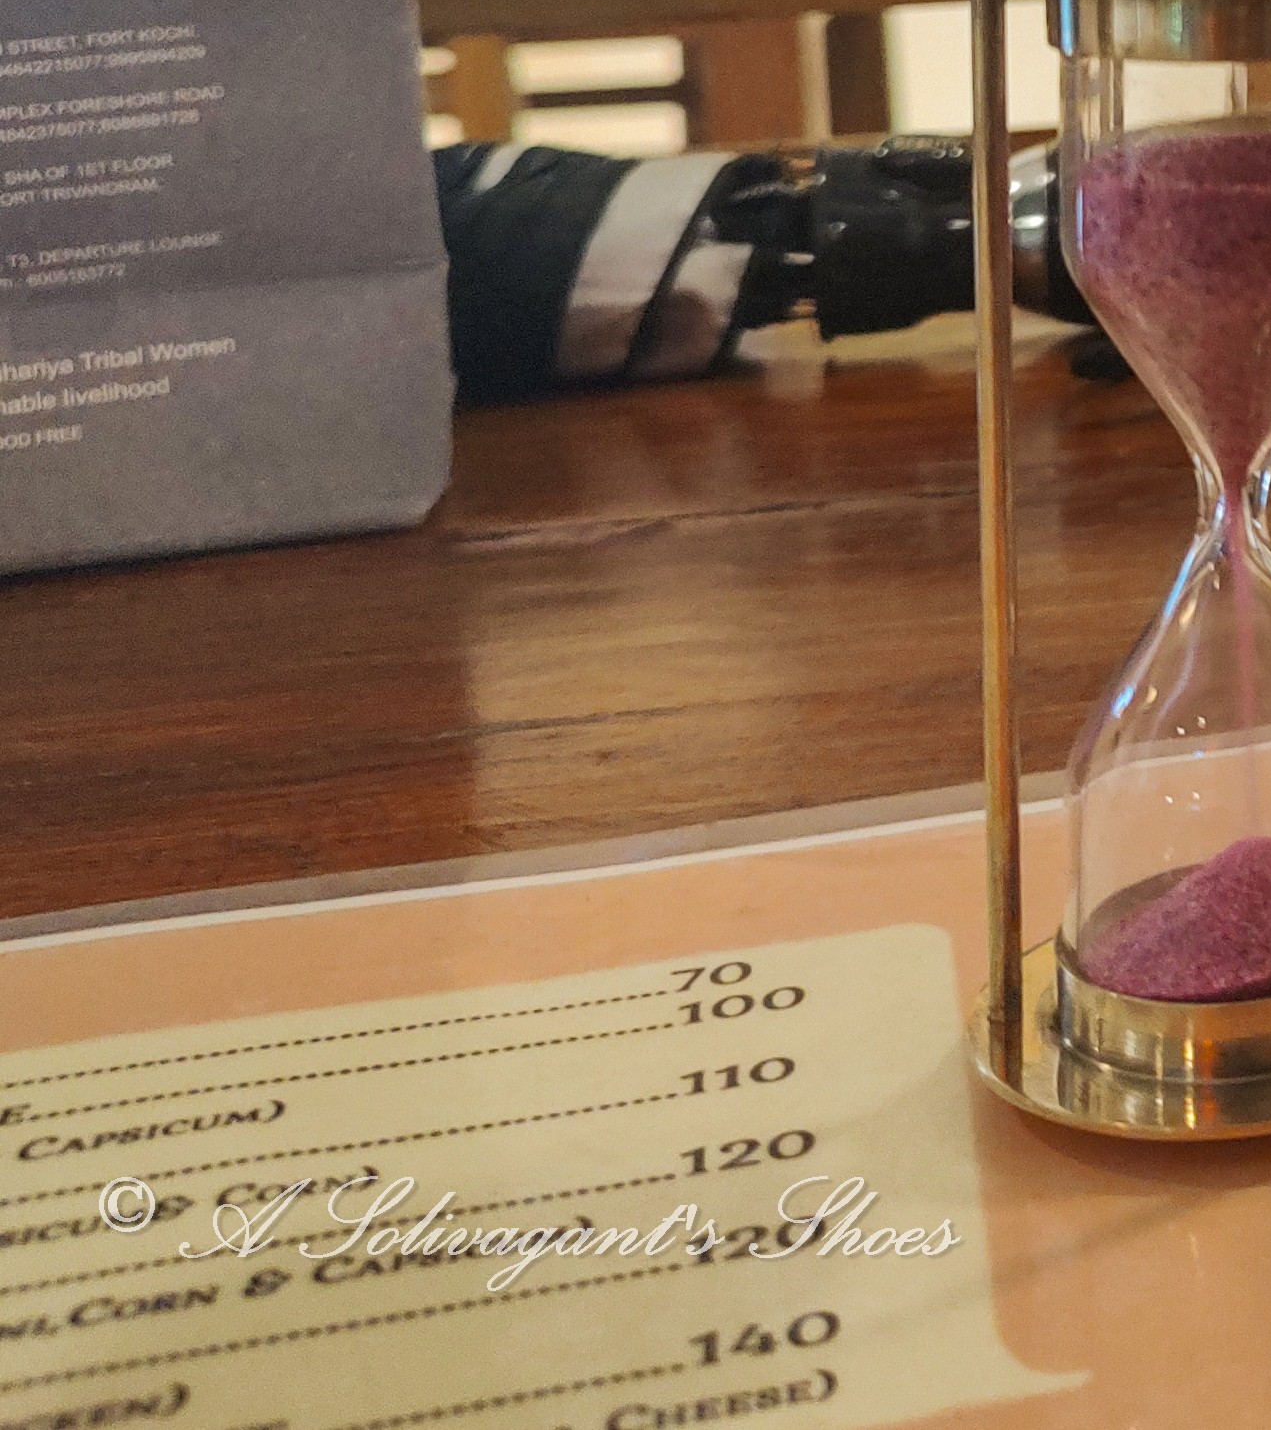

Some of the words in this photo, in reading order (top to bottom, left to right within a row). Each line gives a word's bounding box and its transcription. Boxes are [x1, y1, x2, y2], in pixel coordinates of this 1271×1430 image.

[79, 345, 144, 371] Tribal
[148, 337, 238, 363] Women
[61, 375, 171, 409] livelihood
[670, 961, 753, 993] 70
[678, 986, 806, 1025] 100
[680, 1057, 796, 1096] 110
[680, 1130, 817, 1176] 120
[689, 1310, 841, 1367] 140
